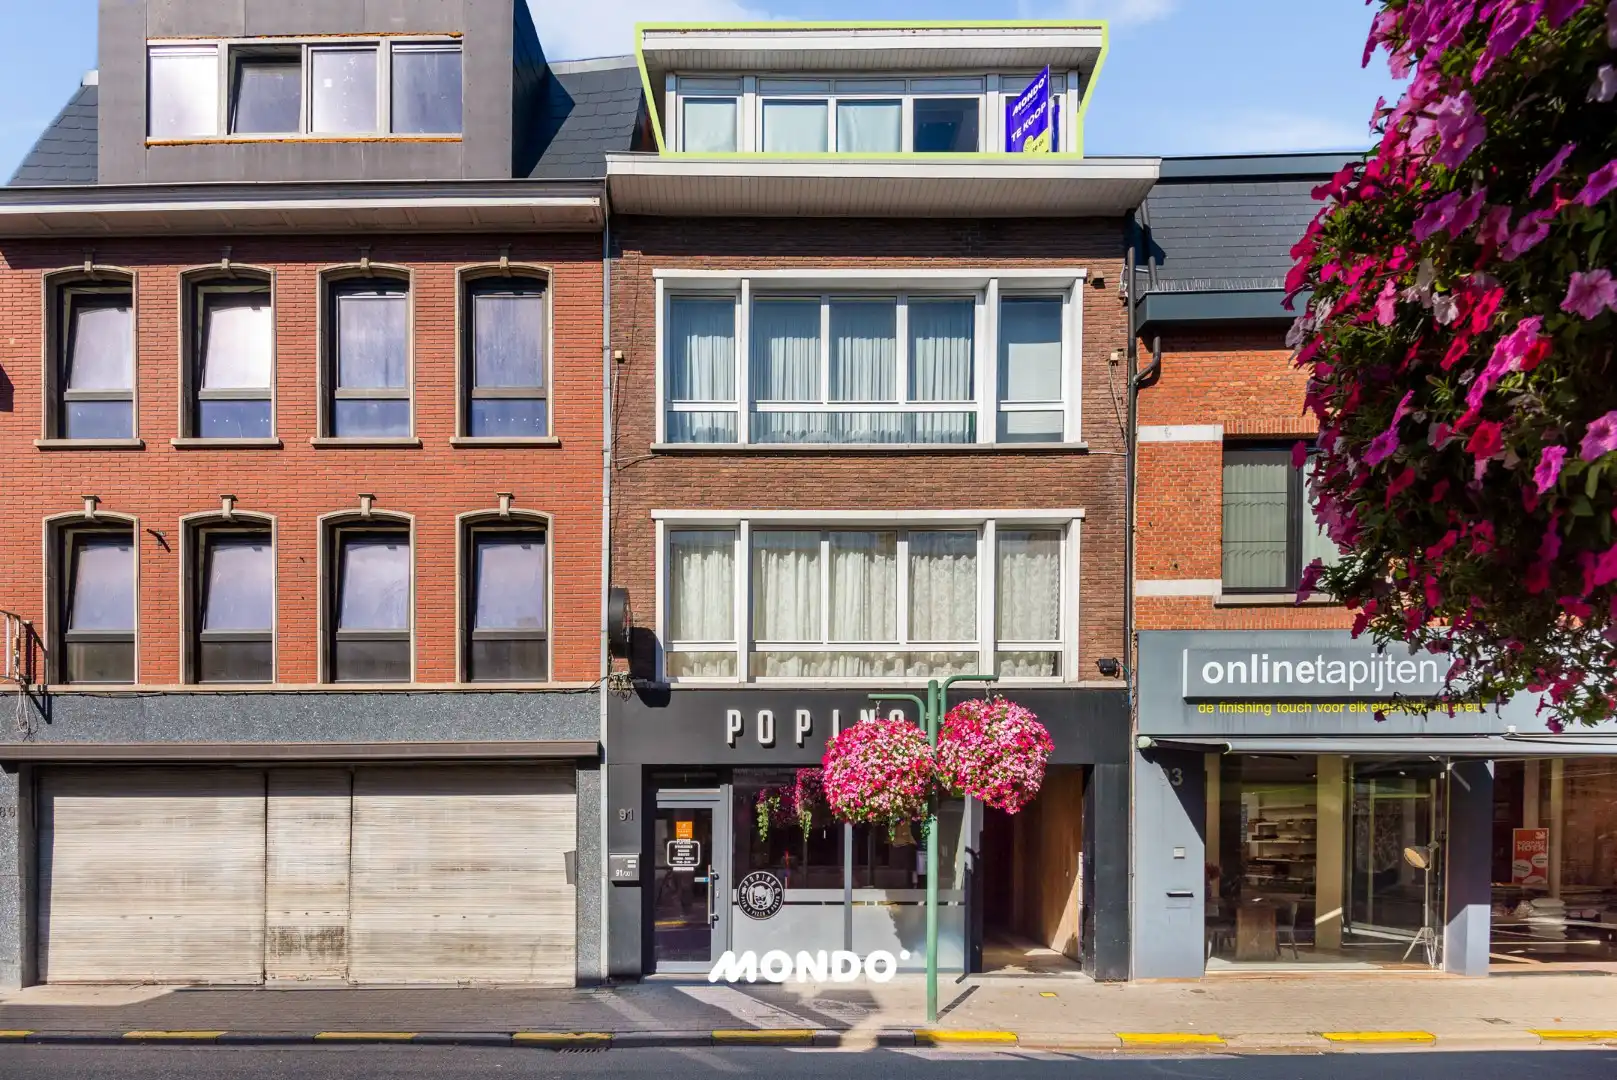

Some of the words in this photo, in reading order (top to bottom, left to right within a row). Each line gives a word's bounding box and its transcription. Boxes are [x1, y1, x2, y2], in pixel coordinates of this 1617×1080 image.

[1012, 77, 1045, 116] MONDO
[1011, 127, 1022, 142] TE
[1023, 101, 1047, 132] KOOP
[1197, 701, 1214, 713] de
[1218, 701, 1272, 716] finishing
[1277, 701, 1312, 713] touch
[1316, 703, 1345, 713] voor
[1349, 701, 1367, 713] elk
[619, 808, 634, 821] 91
